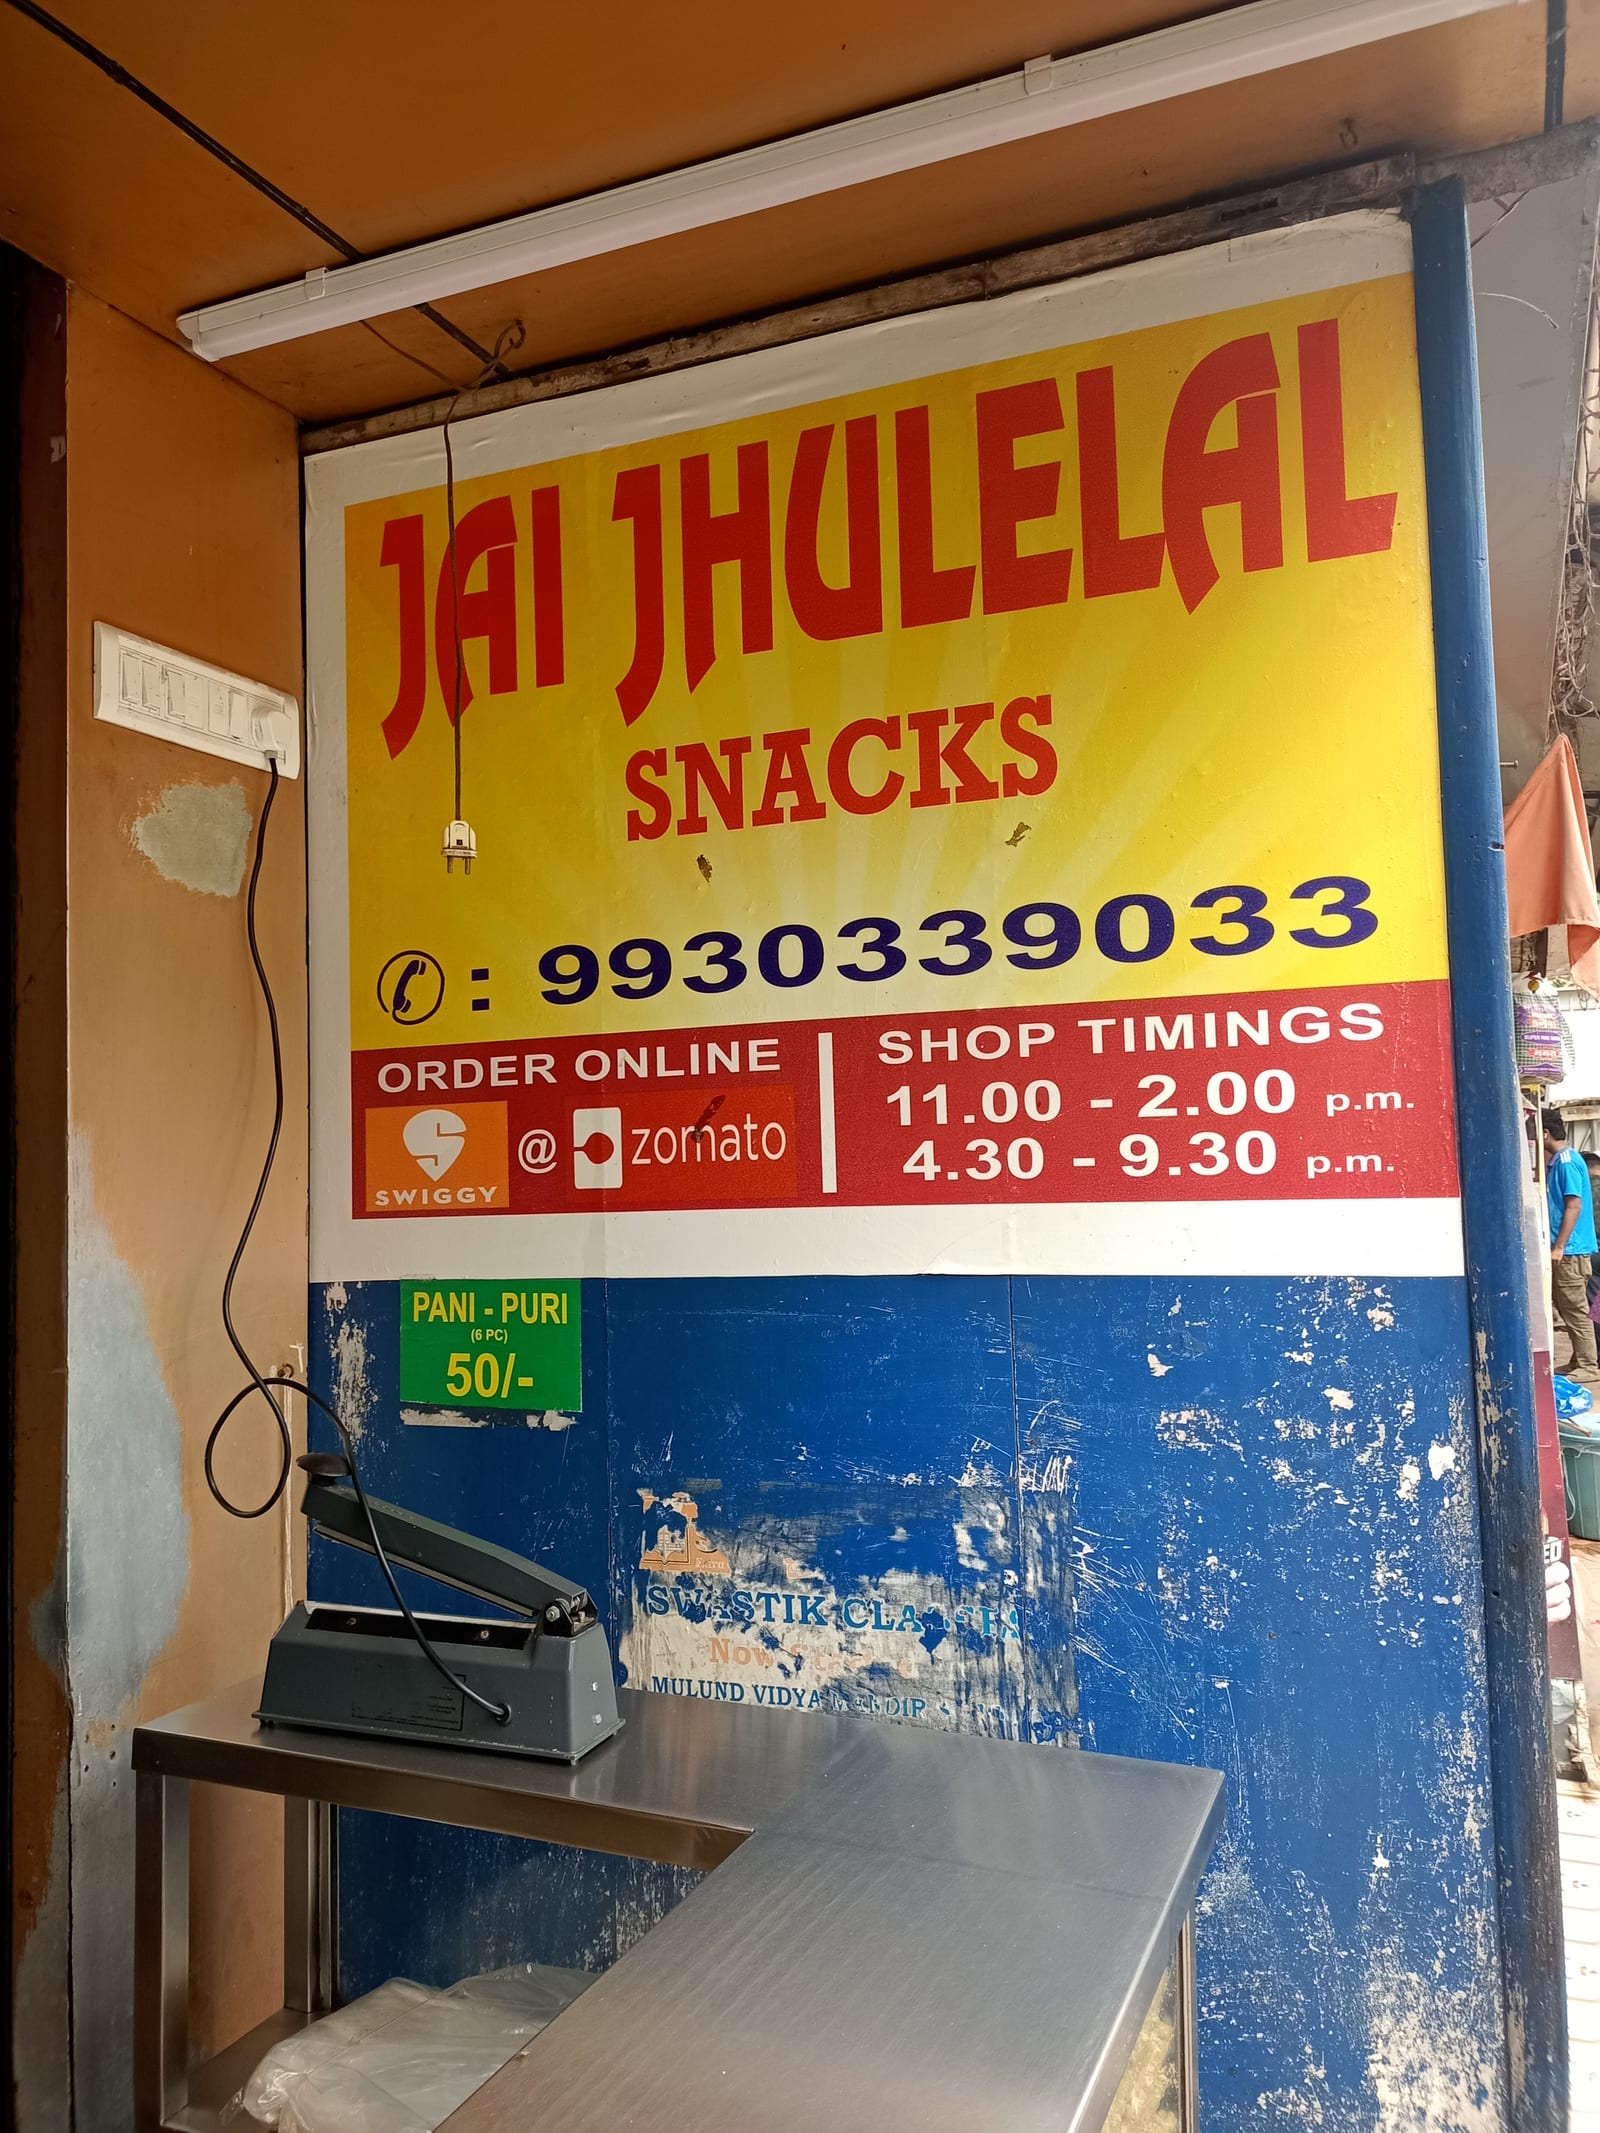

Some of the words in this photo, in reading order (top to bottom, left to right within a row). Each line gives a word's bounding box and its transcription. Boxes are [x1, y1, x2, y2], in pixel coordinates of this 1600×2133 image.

[380, 485, 564, 760] JAI
[612, 318, 1398, 727] JHULELAL
[626, 694, 1057, 842] SNACKS
[538, 876, 1378, 1005] 9930339033
[878, 1022, 1056, 1065] SHOP
[1078, 1002, 1385, 1055] TIMINGS
[378, 1053, 557, 1093] ORDER
[575, 1038, 781, 1082] ONLINE
[886, 1079, 1061, 1126] 11.00
[1136, 1068, 1296, 1118] 2.00
[1326, 1088, 1415, 1117] p.m.
[517, 1129, 558, 1175] @
[631, 1113, 787, 1165] zomato
[903, 1137, 1045, 1181] 4.30
[1120, 1130, 1277, 1177] 9.30
[1307, 1151, 1395, 1179] p.m.
[375, 1186, 498, 1207] SWIGGY
[413, 1292, 475, 1322] PANI
[502, 1293, 567, 1324] PURI
[446, 1352, 534, 1399] 50/-
[710, 1637, 775, 1667] Now
[652, 1676, 745, 1702] MULUND
[752, 1684, 821, 1709] VIDYA
